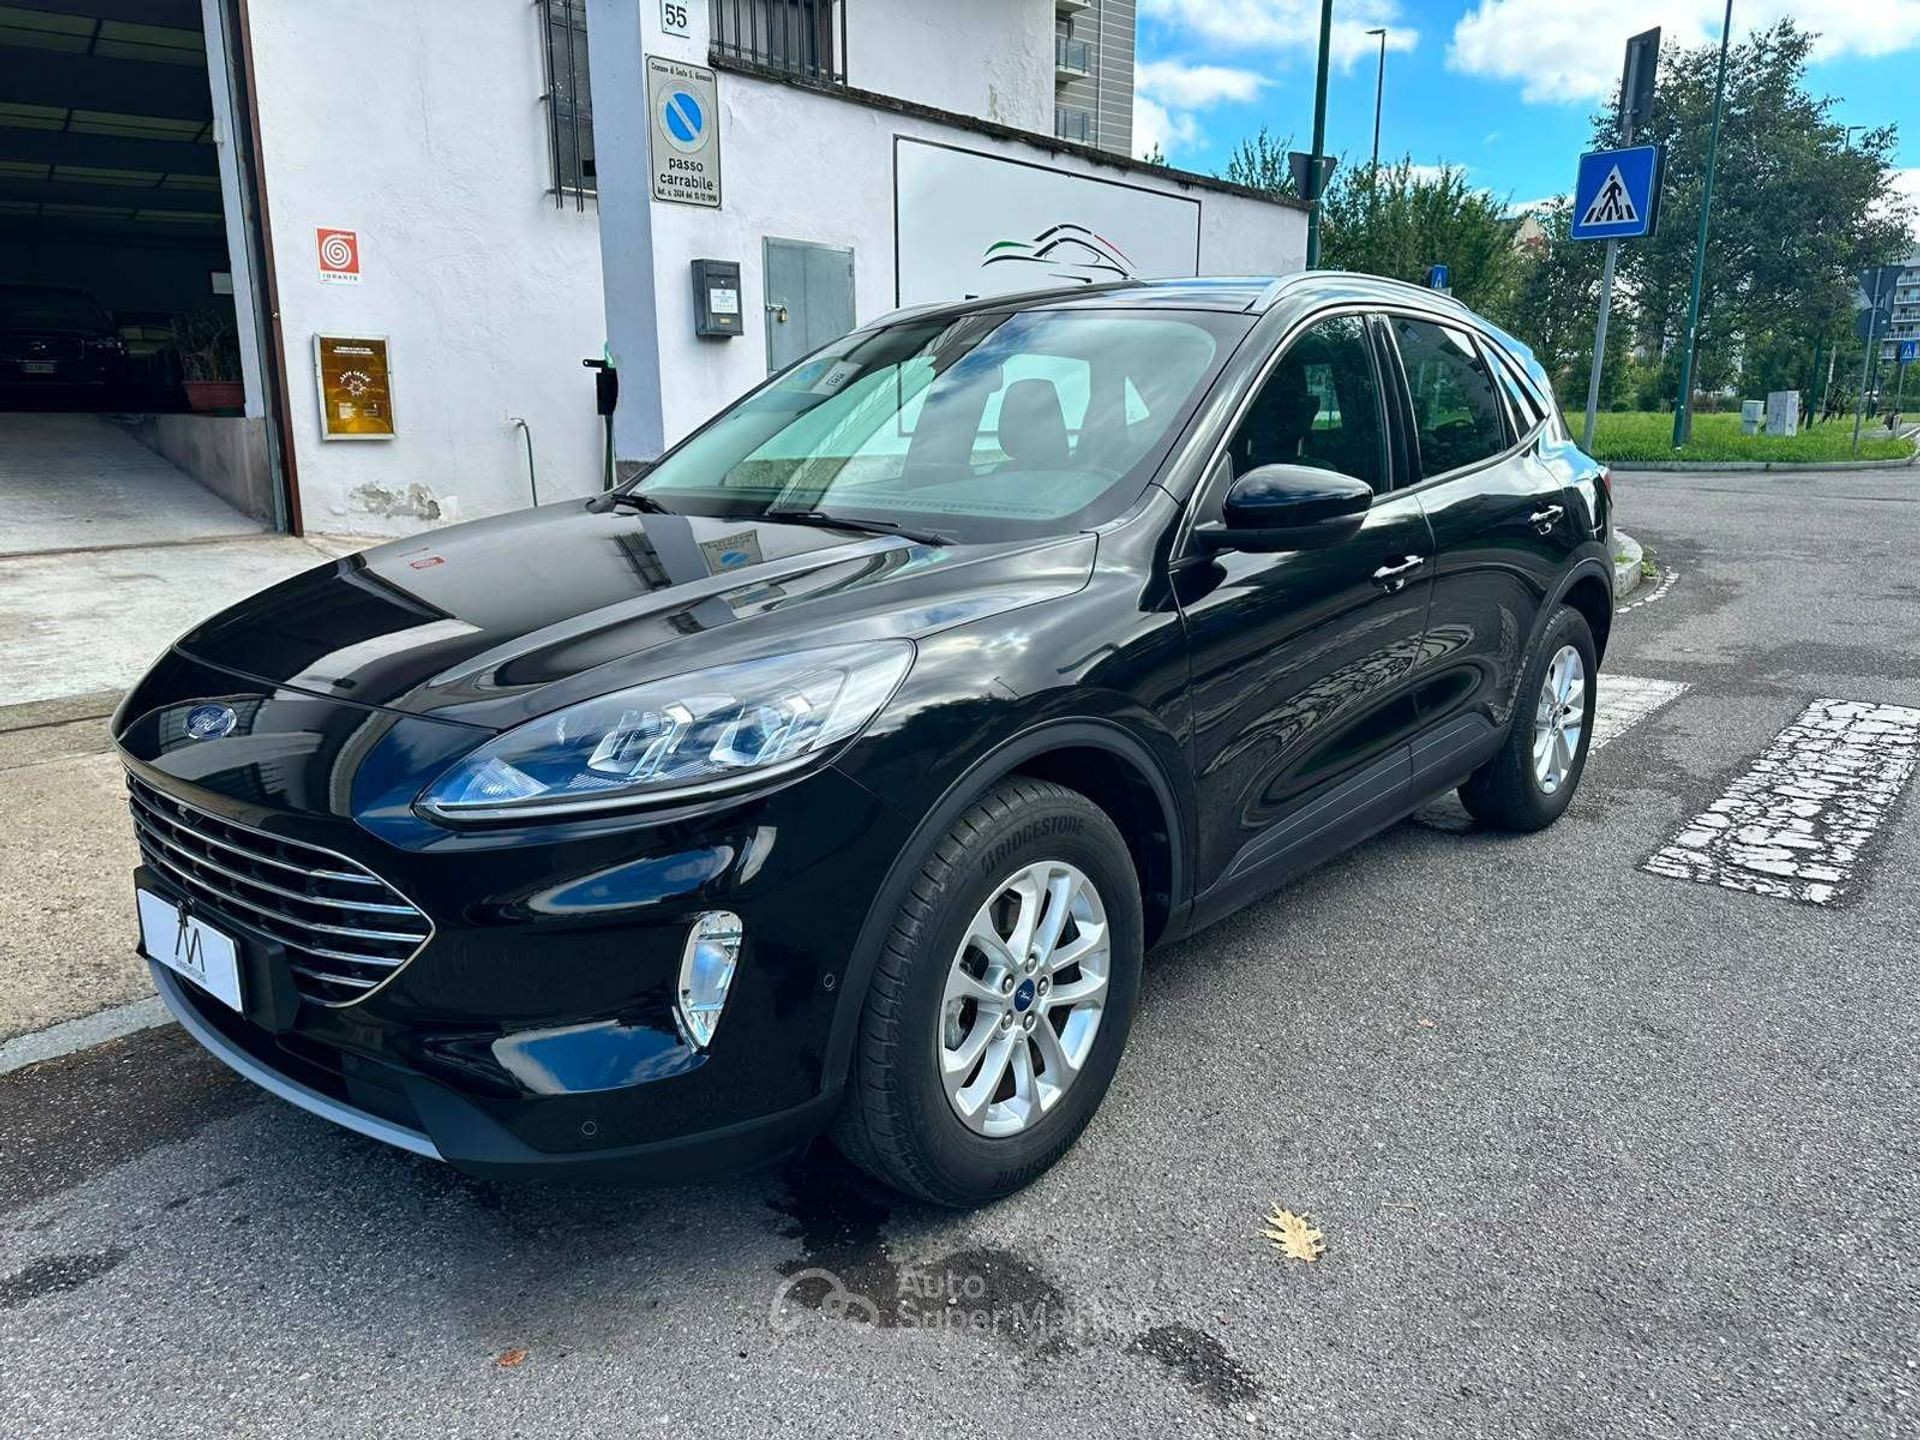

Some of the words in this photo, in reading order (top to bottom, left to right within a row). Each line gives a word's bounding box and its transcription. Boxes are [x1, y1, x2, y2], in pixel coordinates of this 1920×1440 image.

[665, 3, 687, 28] 55
[669, 157, 704, 173] passo
[660, 173, 714, 191] carrabile
[322, 273, 358, 281] IDRANTE
[981, 815, 1086, 878] BRIDGESTONE
